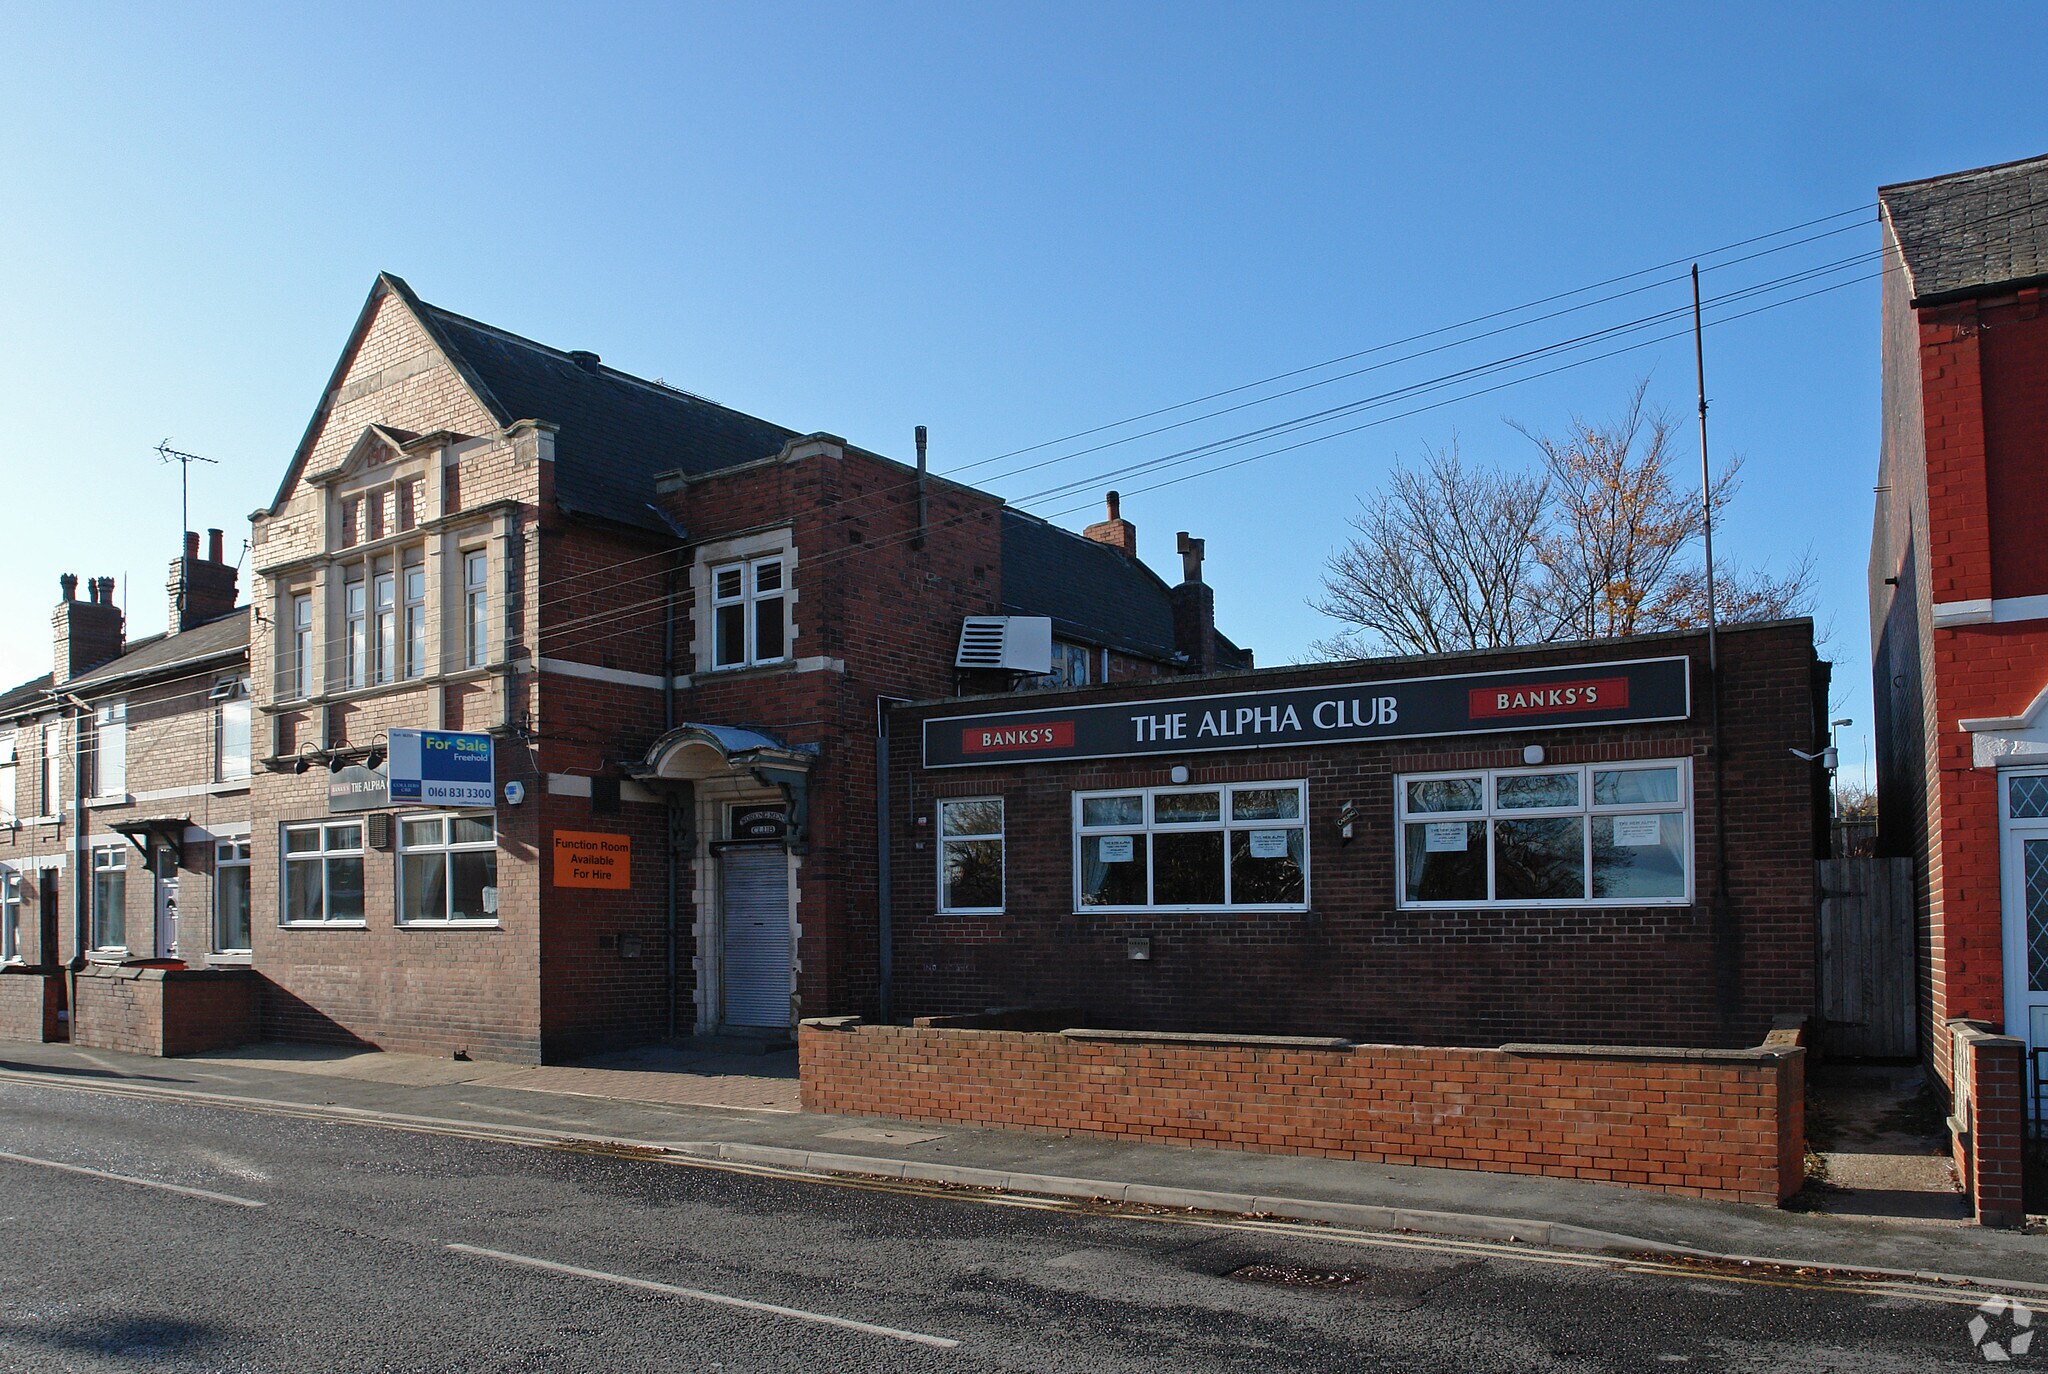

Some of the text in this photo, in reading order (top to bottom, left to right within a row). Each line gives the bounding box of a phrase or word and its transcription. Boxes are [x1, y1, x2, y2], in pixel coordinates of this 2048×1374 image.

[1497, 687, 1597, 710] BANKS'S
[1130, 696, 1398, 742] THE ALPHA CLUB
[982, 728, 1053, 747] BANKS'S
[426, 737, 487, 752] For Sale
[454, 753, 488, 762] Freehold
[351, 780, 386, 792] THE ALPHA
[428, 787, 491, 798] 0161 831 3300
[555, 838, 629, 852] Function Room
[570, 854, 614, 865] Available
[573, 869, 612, 880] For Hire
